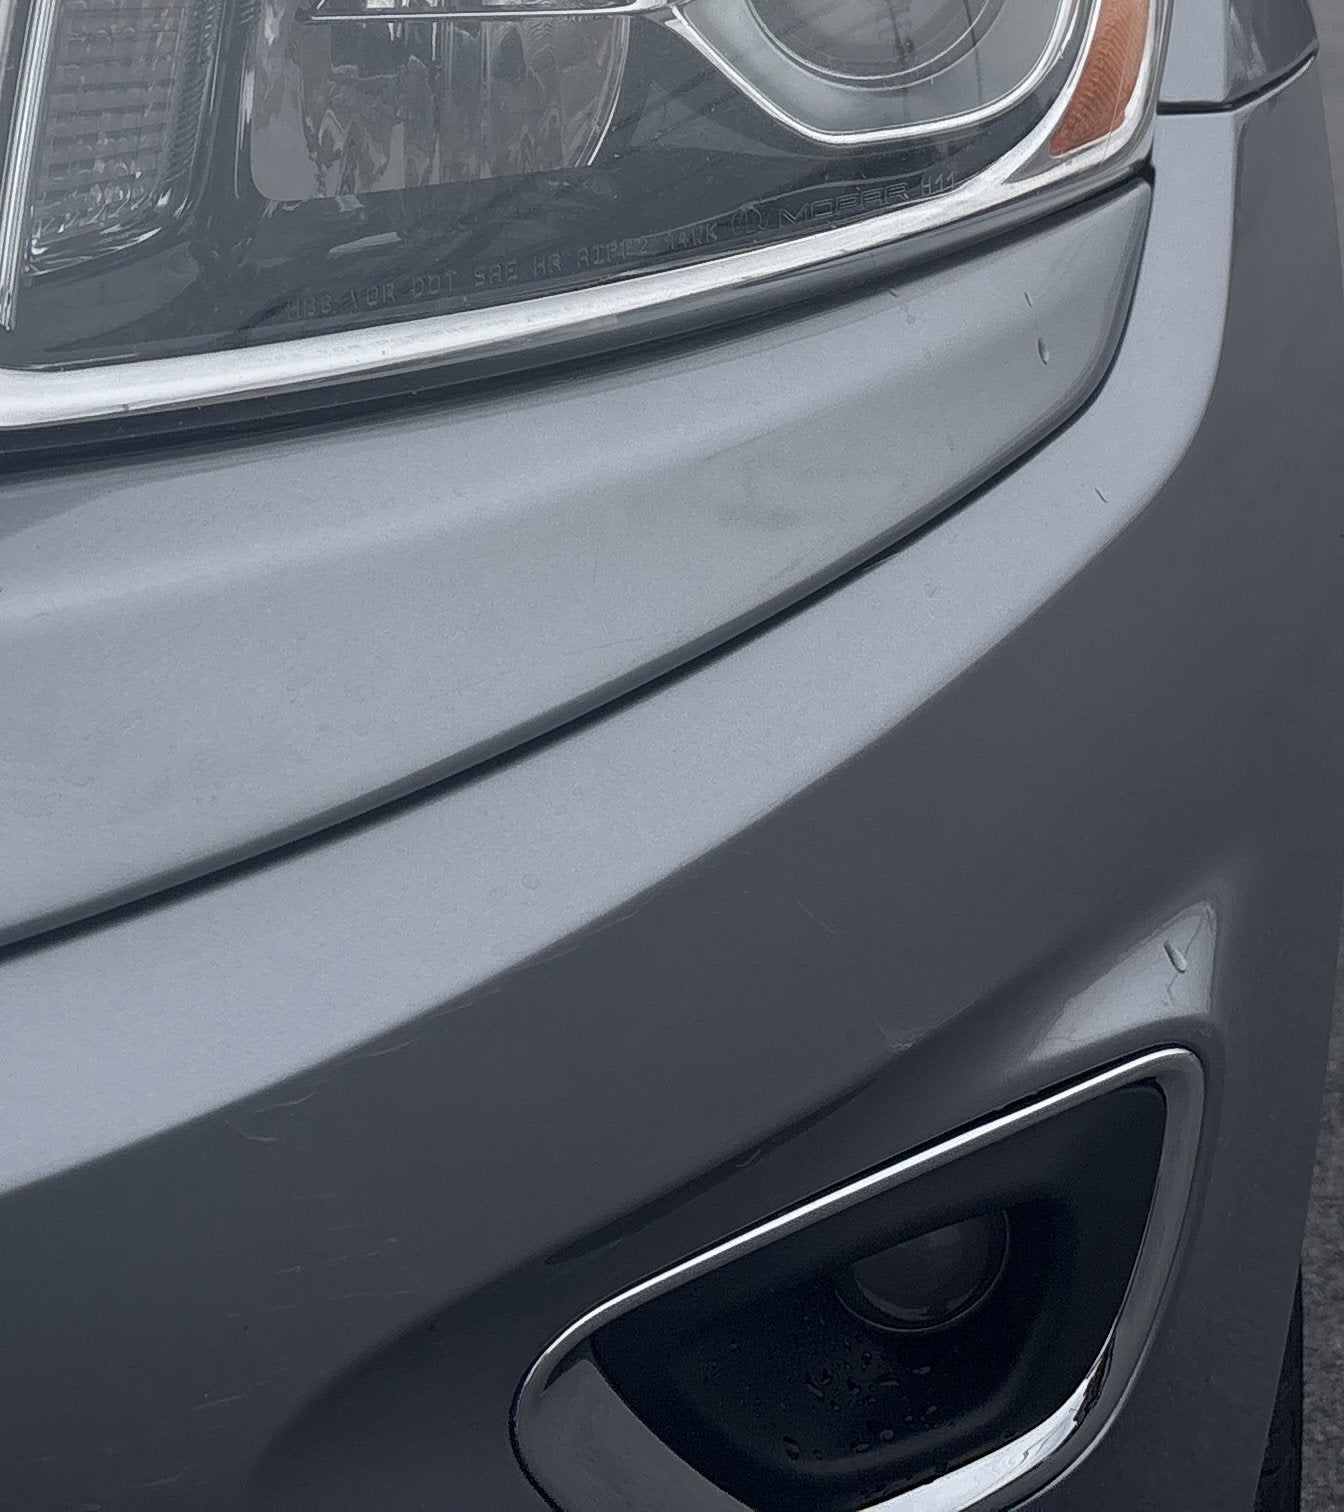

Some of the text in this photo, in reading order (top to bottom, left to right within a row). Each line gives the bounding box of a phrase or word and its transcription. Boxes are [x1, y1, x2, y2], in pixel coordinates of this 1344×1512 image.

[412, 270, 458, 298] DOT
[474, 259, 519, 287] SAE
[778, 181, 910, 228] MOPAR
